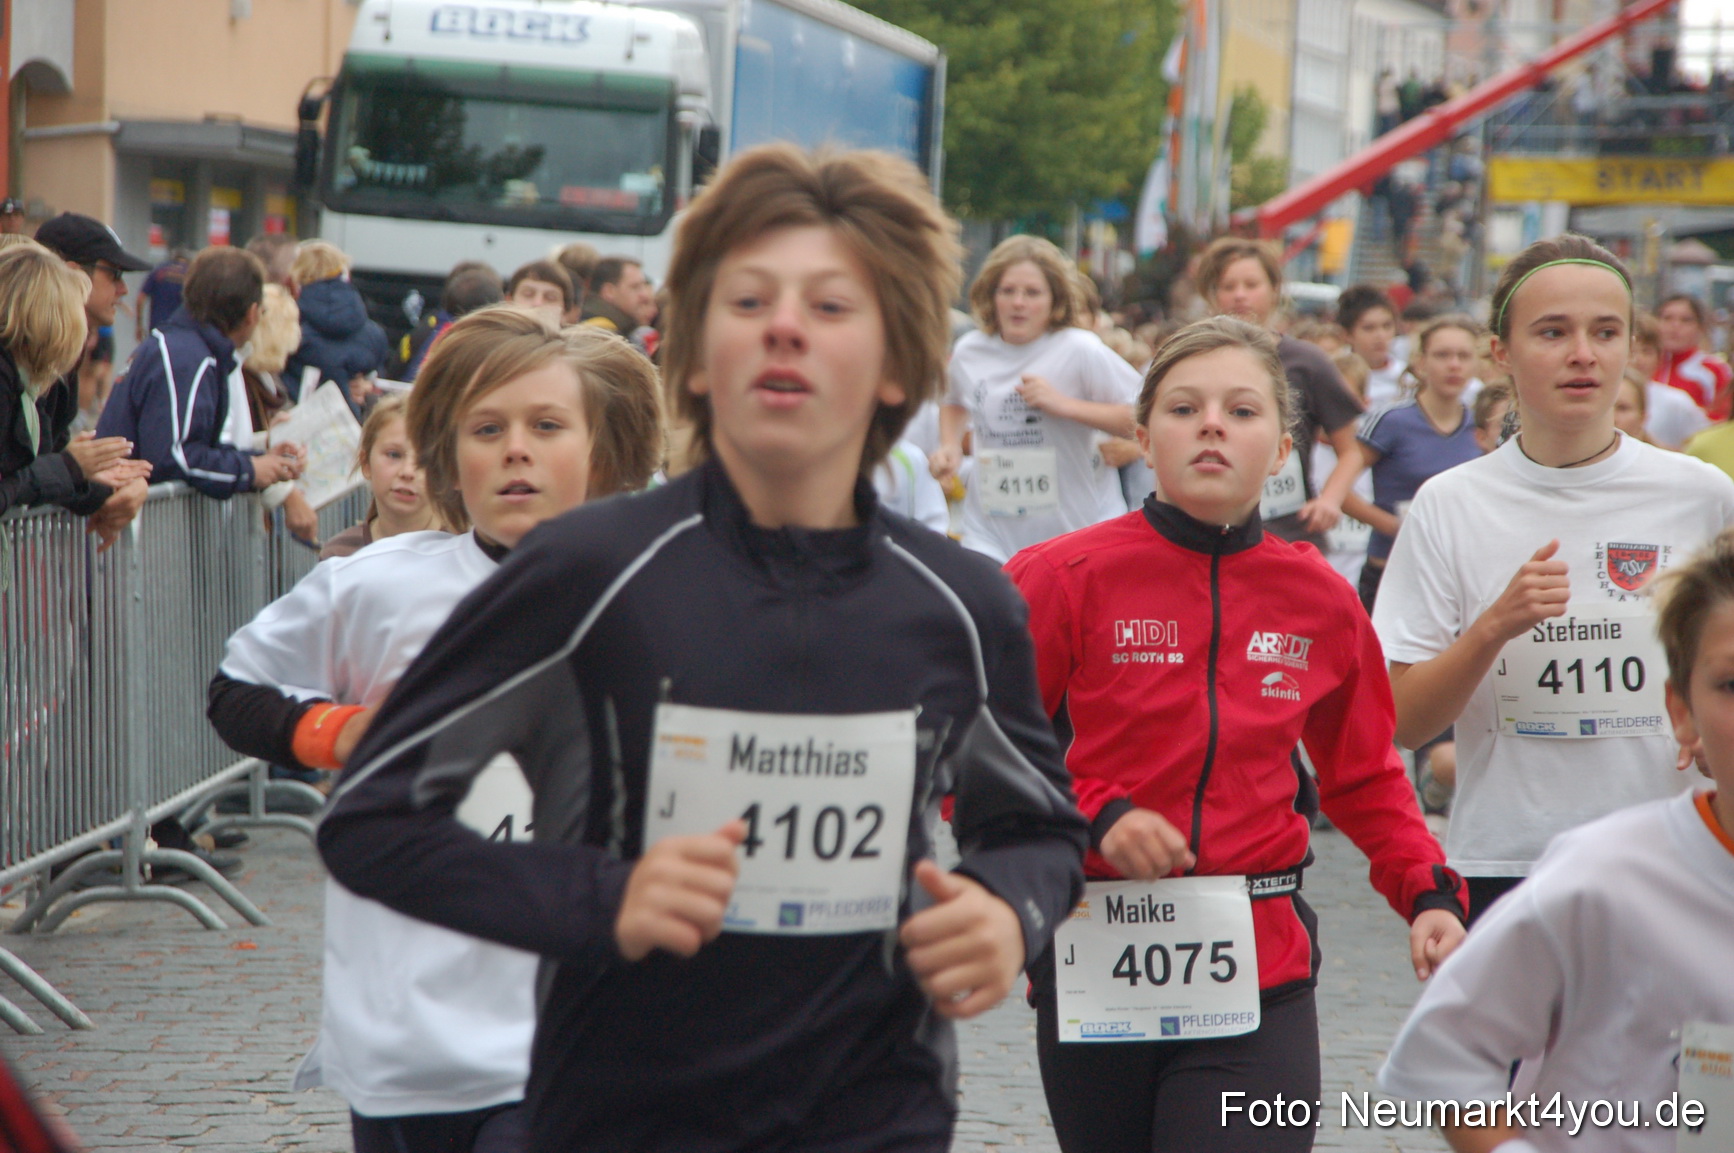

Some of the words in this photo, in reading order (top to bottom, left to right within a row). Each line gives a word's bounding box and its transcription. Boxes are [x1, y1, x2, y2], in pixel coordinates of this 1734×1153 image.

[430, 5, 590, 42] BOCK
[1597, 162, 1707, 191] START
[1000, 475, 1049, 494] 4116
[1264, 476, 1295, 497] 139
[1619, 560, 1647, 576] ASV
[1115, 619, 1178, 647] HDI
[1533, 617, 1622, 642] Stefanie
[1247, 631, 1313, 660] ARNDT
[1112, 653, 1129, 663] SC
[1132, 652, 1164, 663] ROTH
[1498, 658, 1507, 676] J
[1537, 656, 1646, 694] 4110
[1261, 686, 1301, 701] skinfit
[1516, 721, 1556, 732] BOCK
[1599, 716, 1663, 729] PFLEIDERER
[729, 732, 869, 777] Matthias
[658, 791, 676, 818] J
[739, 802, 884, 861] 4102
[1106, 894, 1176, 924] Maike
[1064, 944, 1075, 965] J
[1112, 940, 1238, 986] 4075
[1081, 1021, 1132, 1033] BOCK
[1182, 1012, 1256, 1028] PFLEIDERER
